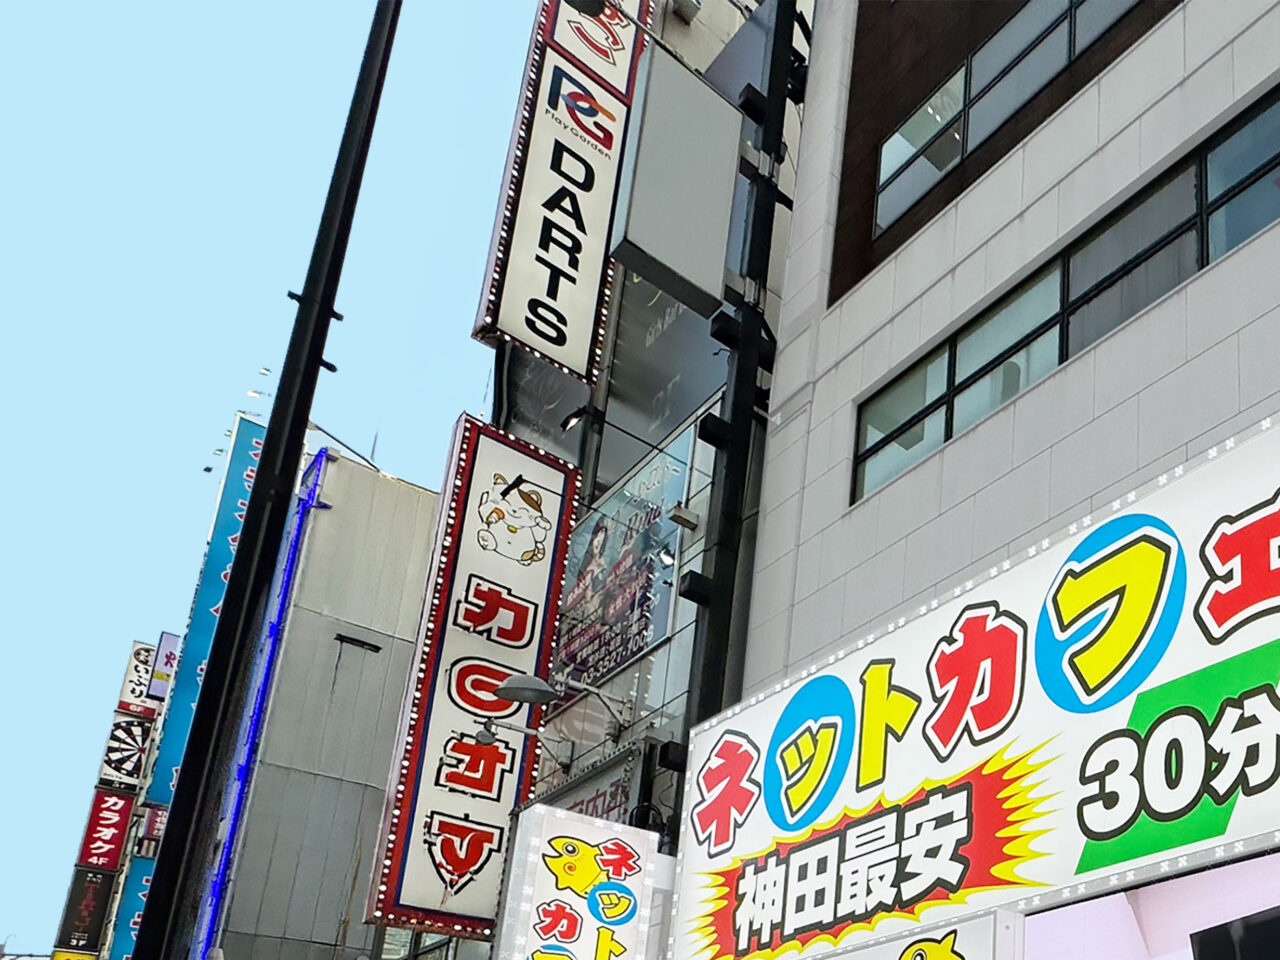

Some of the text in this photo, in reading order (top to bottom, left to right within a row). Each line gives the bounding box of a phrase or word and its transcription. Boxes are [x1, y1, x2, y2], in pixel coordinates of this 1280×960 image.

[524, 137, 596, 348] DARTS
[87, 855, 109, 866] 4F
[89, 795, 126, 854] カラオケ
[733, 782, 972, 956] 神田最安
